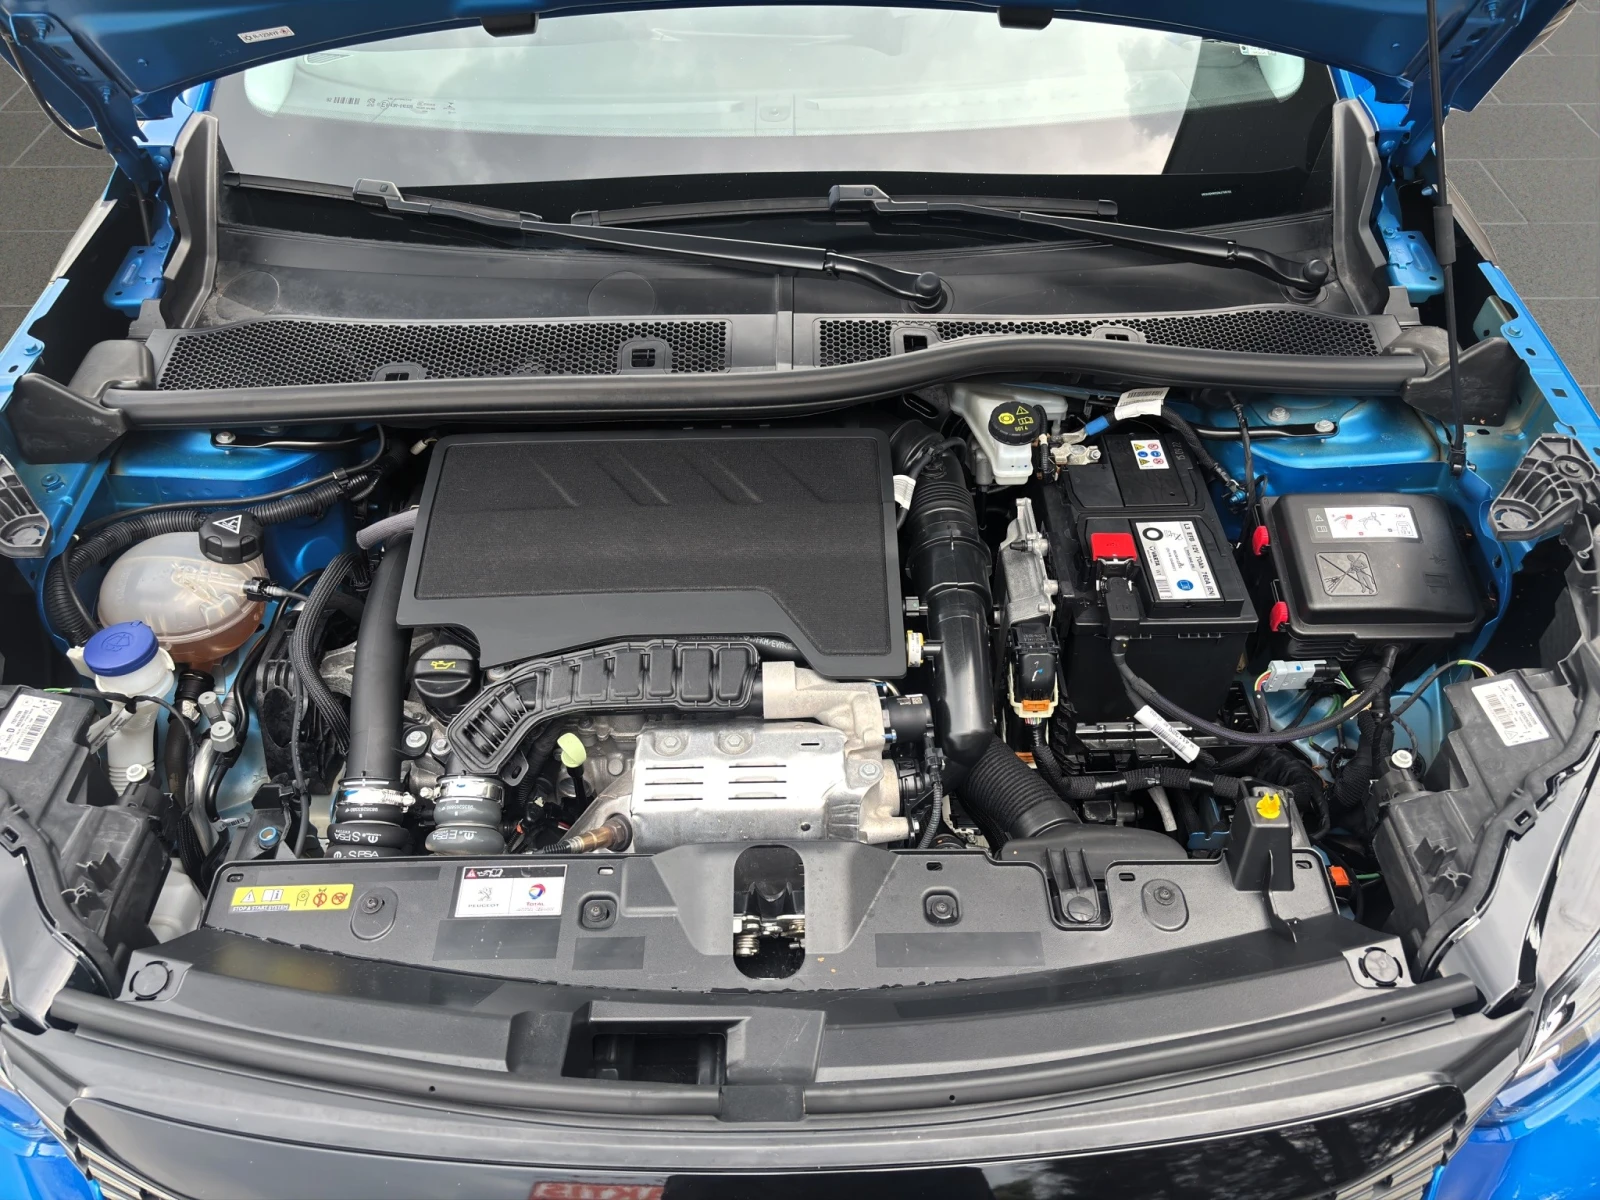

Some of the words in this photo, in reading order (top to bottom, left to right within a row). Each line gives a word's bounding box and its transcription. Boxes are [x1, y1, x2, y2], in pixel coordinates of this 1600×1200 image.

[1192, 544, 1200, 554] 12V
[1151, 551, 1160, 566] VARTA
[334, 832, 351, 842] PSA
[432, 832, 448, 840] PSA
